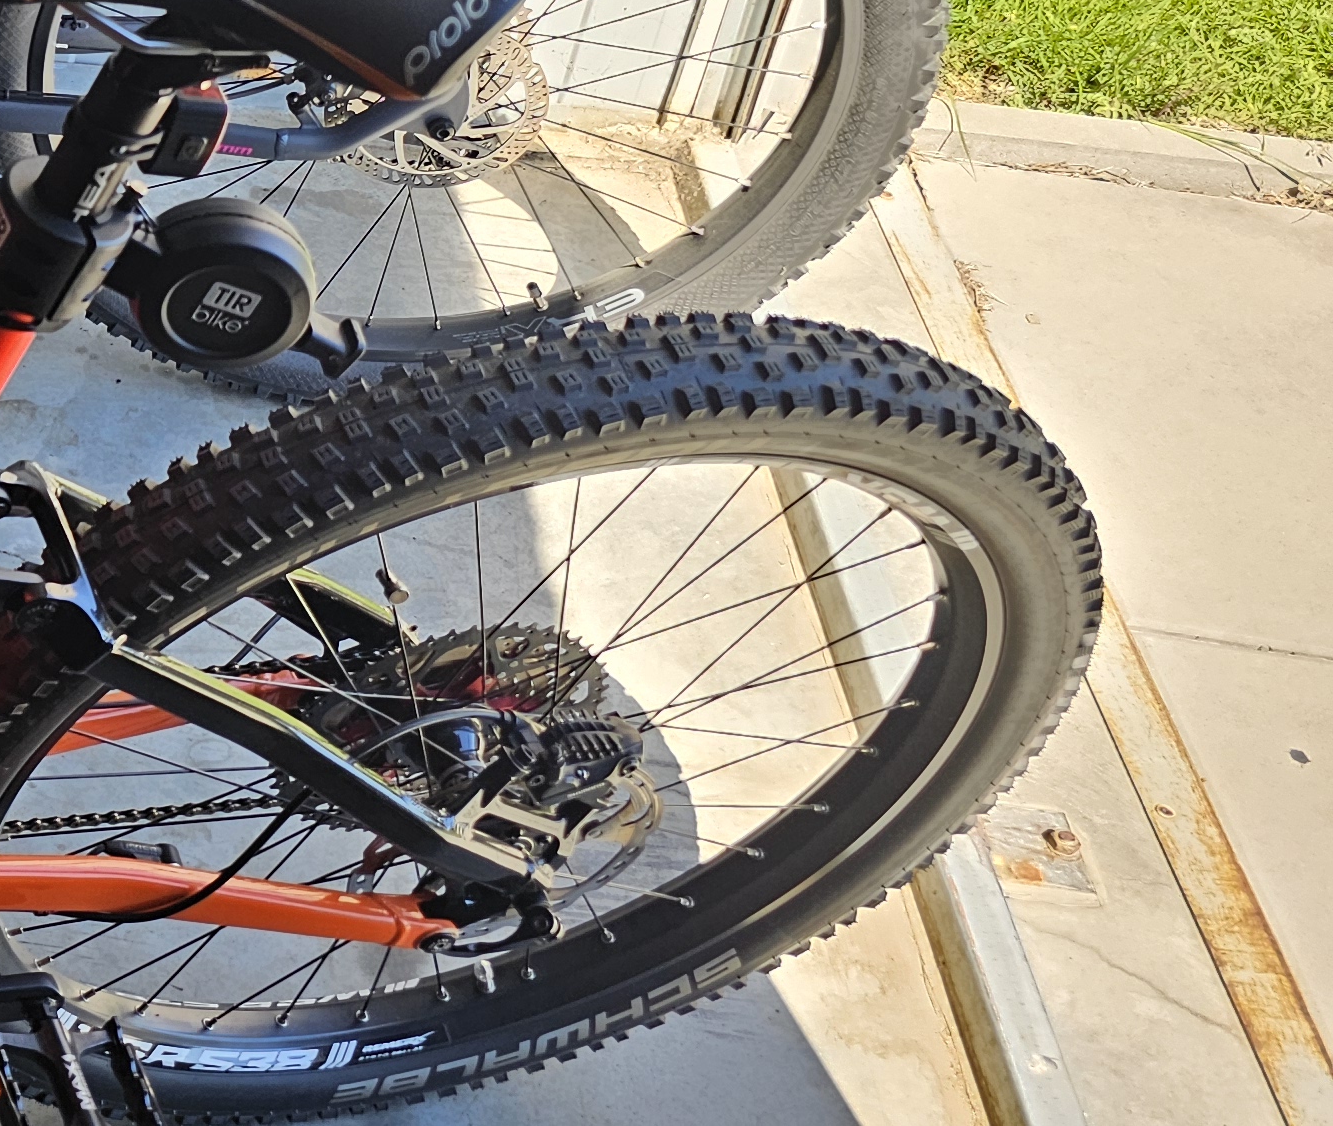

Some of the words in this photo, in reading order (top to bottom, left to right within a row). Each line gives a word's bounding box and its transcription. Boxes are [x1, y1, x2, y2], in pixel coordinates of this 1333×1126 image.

[191, 304, 243, 333] bike
[214, 286, 253, 313] TIR
[329, 948, 743, 1105] SCHWALBE
[61, 1054, 98, 1110] MAXI
